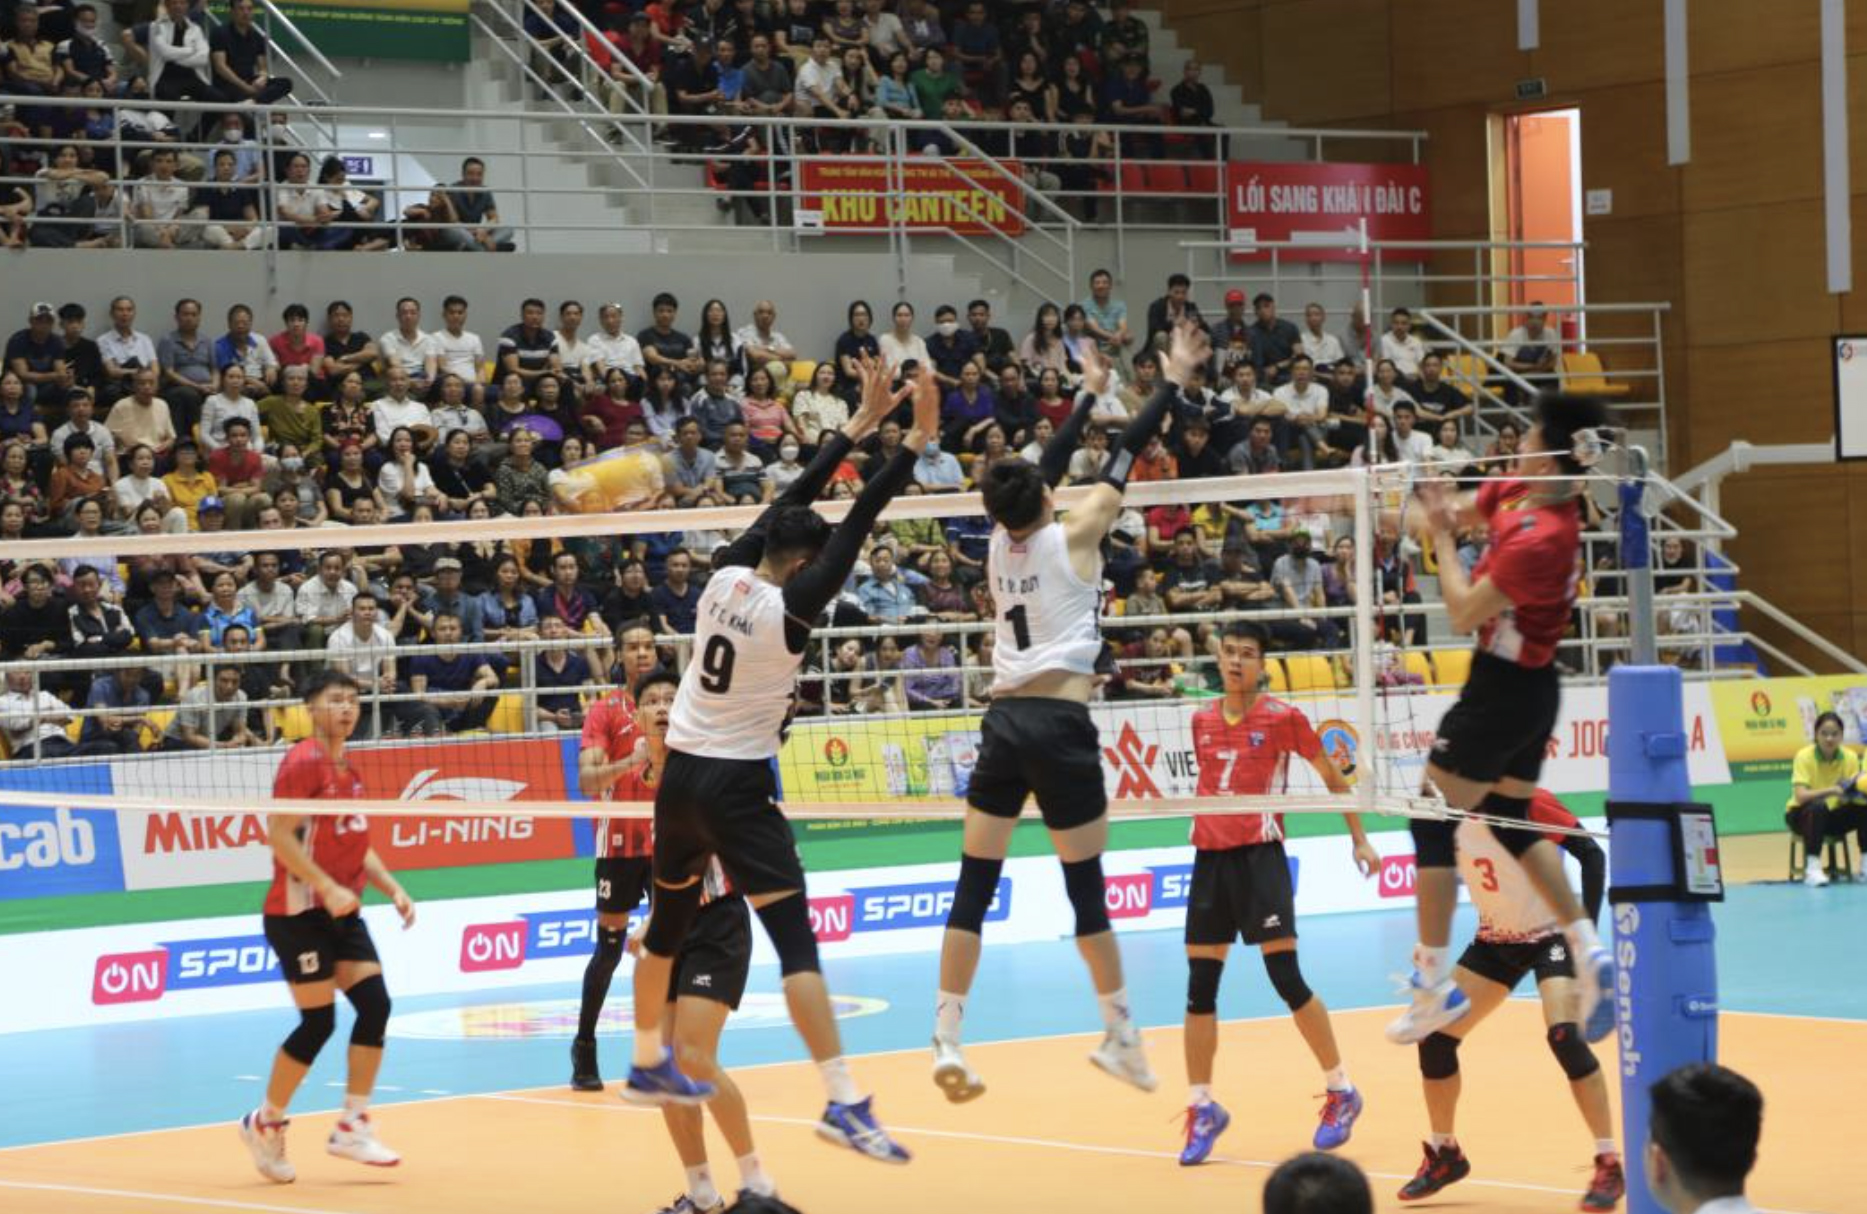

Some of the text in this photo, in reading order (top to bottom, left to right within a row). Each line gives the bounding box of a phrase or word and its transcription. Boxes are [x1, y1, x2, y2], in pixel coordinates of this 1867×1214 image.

[821, 188, 876, 223] KHU
[1236, 174, 1265, 213] LỐI
[1270, 184, 1318, 214] SANG
[1408, 186, 1422, 214] C
[1004, 604, 1032, 652] 1
[701, 634, 736, 694] 9
[1164, 751, 1197, 777] VIE
[1216, 749, 1238, 790] 7
[144, 811, 268, 854] MIKA
[391, 815, 534, 848] LI-NING
[1473, 857, 1500, 893] 3
[1105, 883, 1147, 910] ON
[467, 932, 520, 962] ON
[101, 960, 160, 994] ON
[1617, 939, 1642, 1077] Senoh
